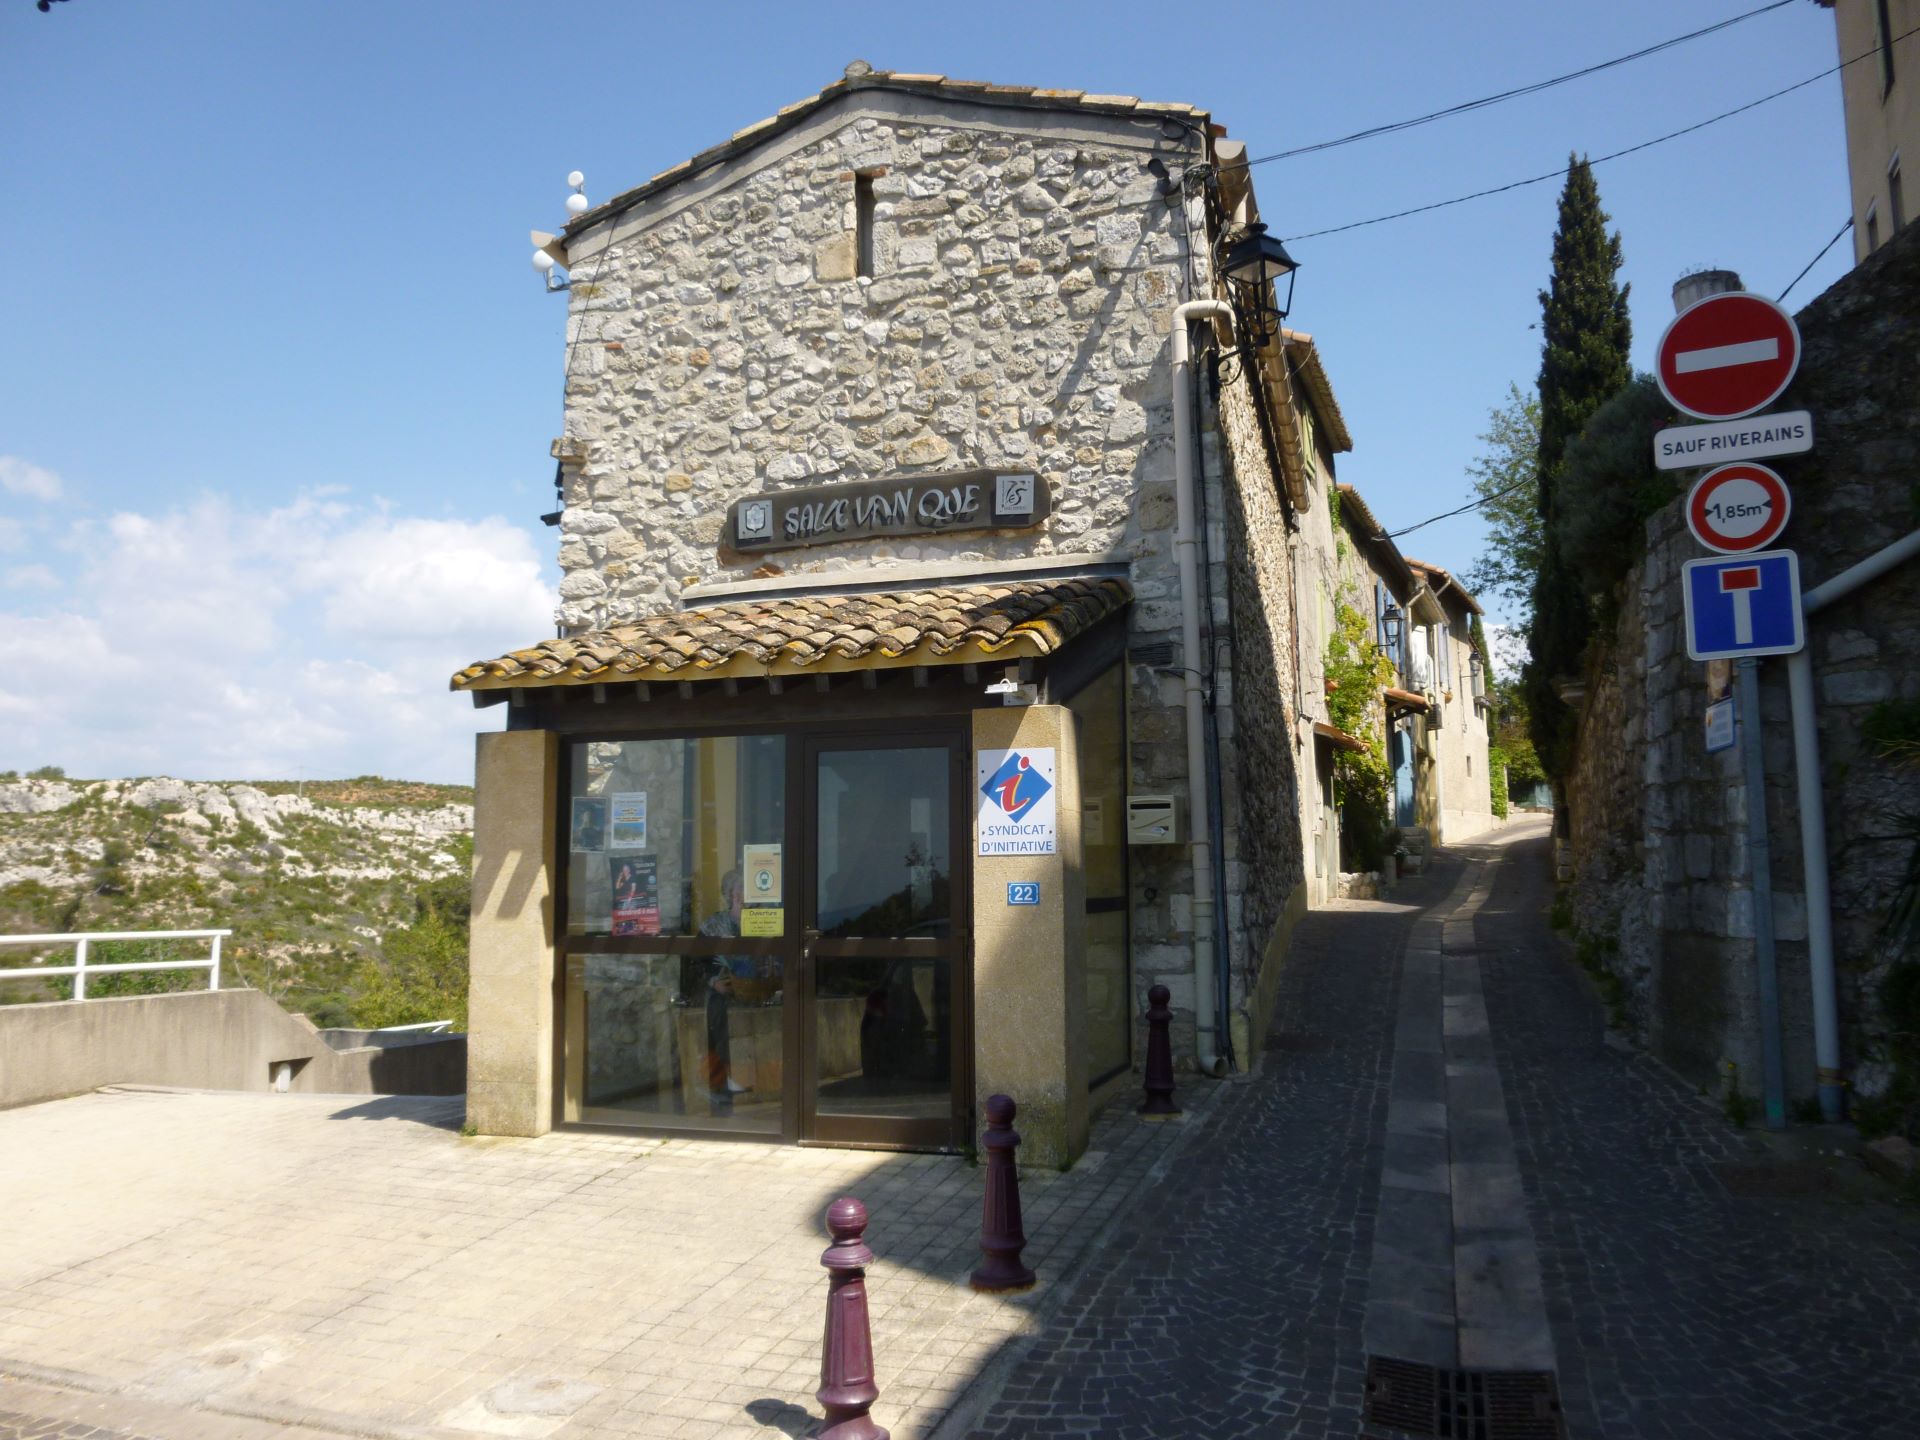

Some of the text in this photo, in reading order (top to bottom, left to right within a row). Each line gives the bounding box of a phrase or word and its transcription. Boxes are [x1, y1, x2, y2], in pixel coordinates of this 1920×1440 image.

[1663, 425, 1805, 455] SAUF RIVERAINS
[1712, 503, 1762, 523] 1,85m
[988, 824, 1046, 836] SYNDICAT
[982, 840, 1052, 852] D'INITIATIVE
[1014, 886, 1033, 901] 22
